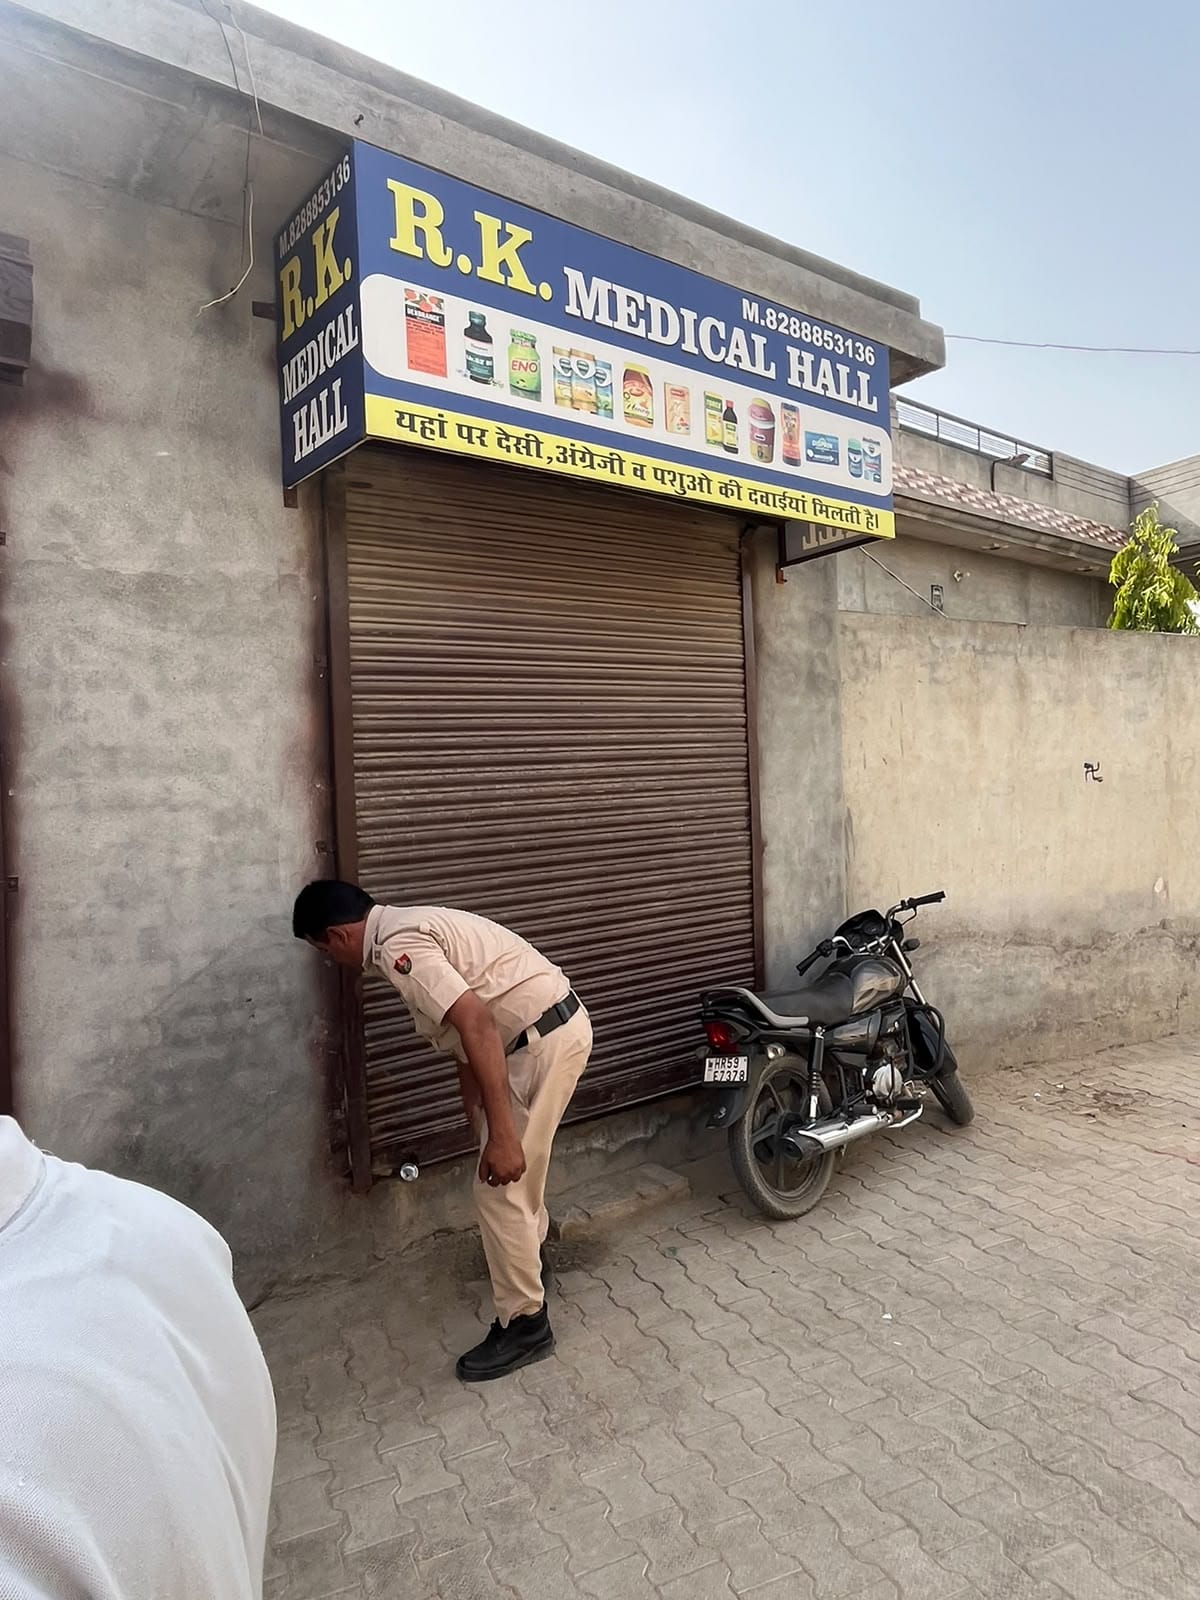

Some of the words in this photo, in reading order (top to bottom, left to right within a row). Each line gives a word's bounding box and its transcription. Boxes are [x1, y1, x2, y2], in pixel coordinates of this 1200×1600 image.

[280, 206, 352, 342] R.K.
[386, 178, 553, 301] R.K.
[282, 303, 359, 405] MEDICAL
[511, 360, 538, 373] ENO
[563, 266, 776, 380] MEDICAL
[786, 345, 878, 412] HALL
[742, 298, 876, 366] M.8288853136
[293, 377, 348, 463] HALL
[395, 409, 448, 441] यहां
[456, 422, 489, 448] पर
[631, 461, 647, 481] व
[718, 480, 743, 501] की
[747, 487, 807, 514] दवाईयां
[812, 498, 862, 526] मिलती
[715, 1057, 739, 1069] HR59
